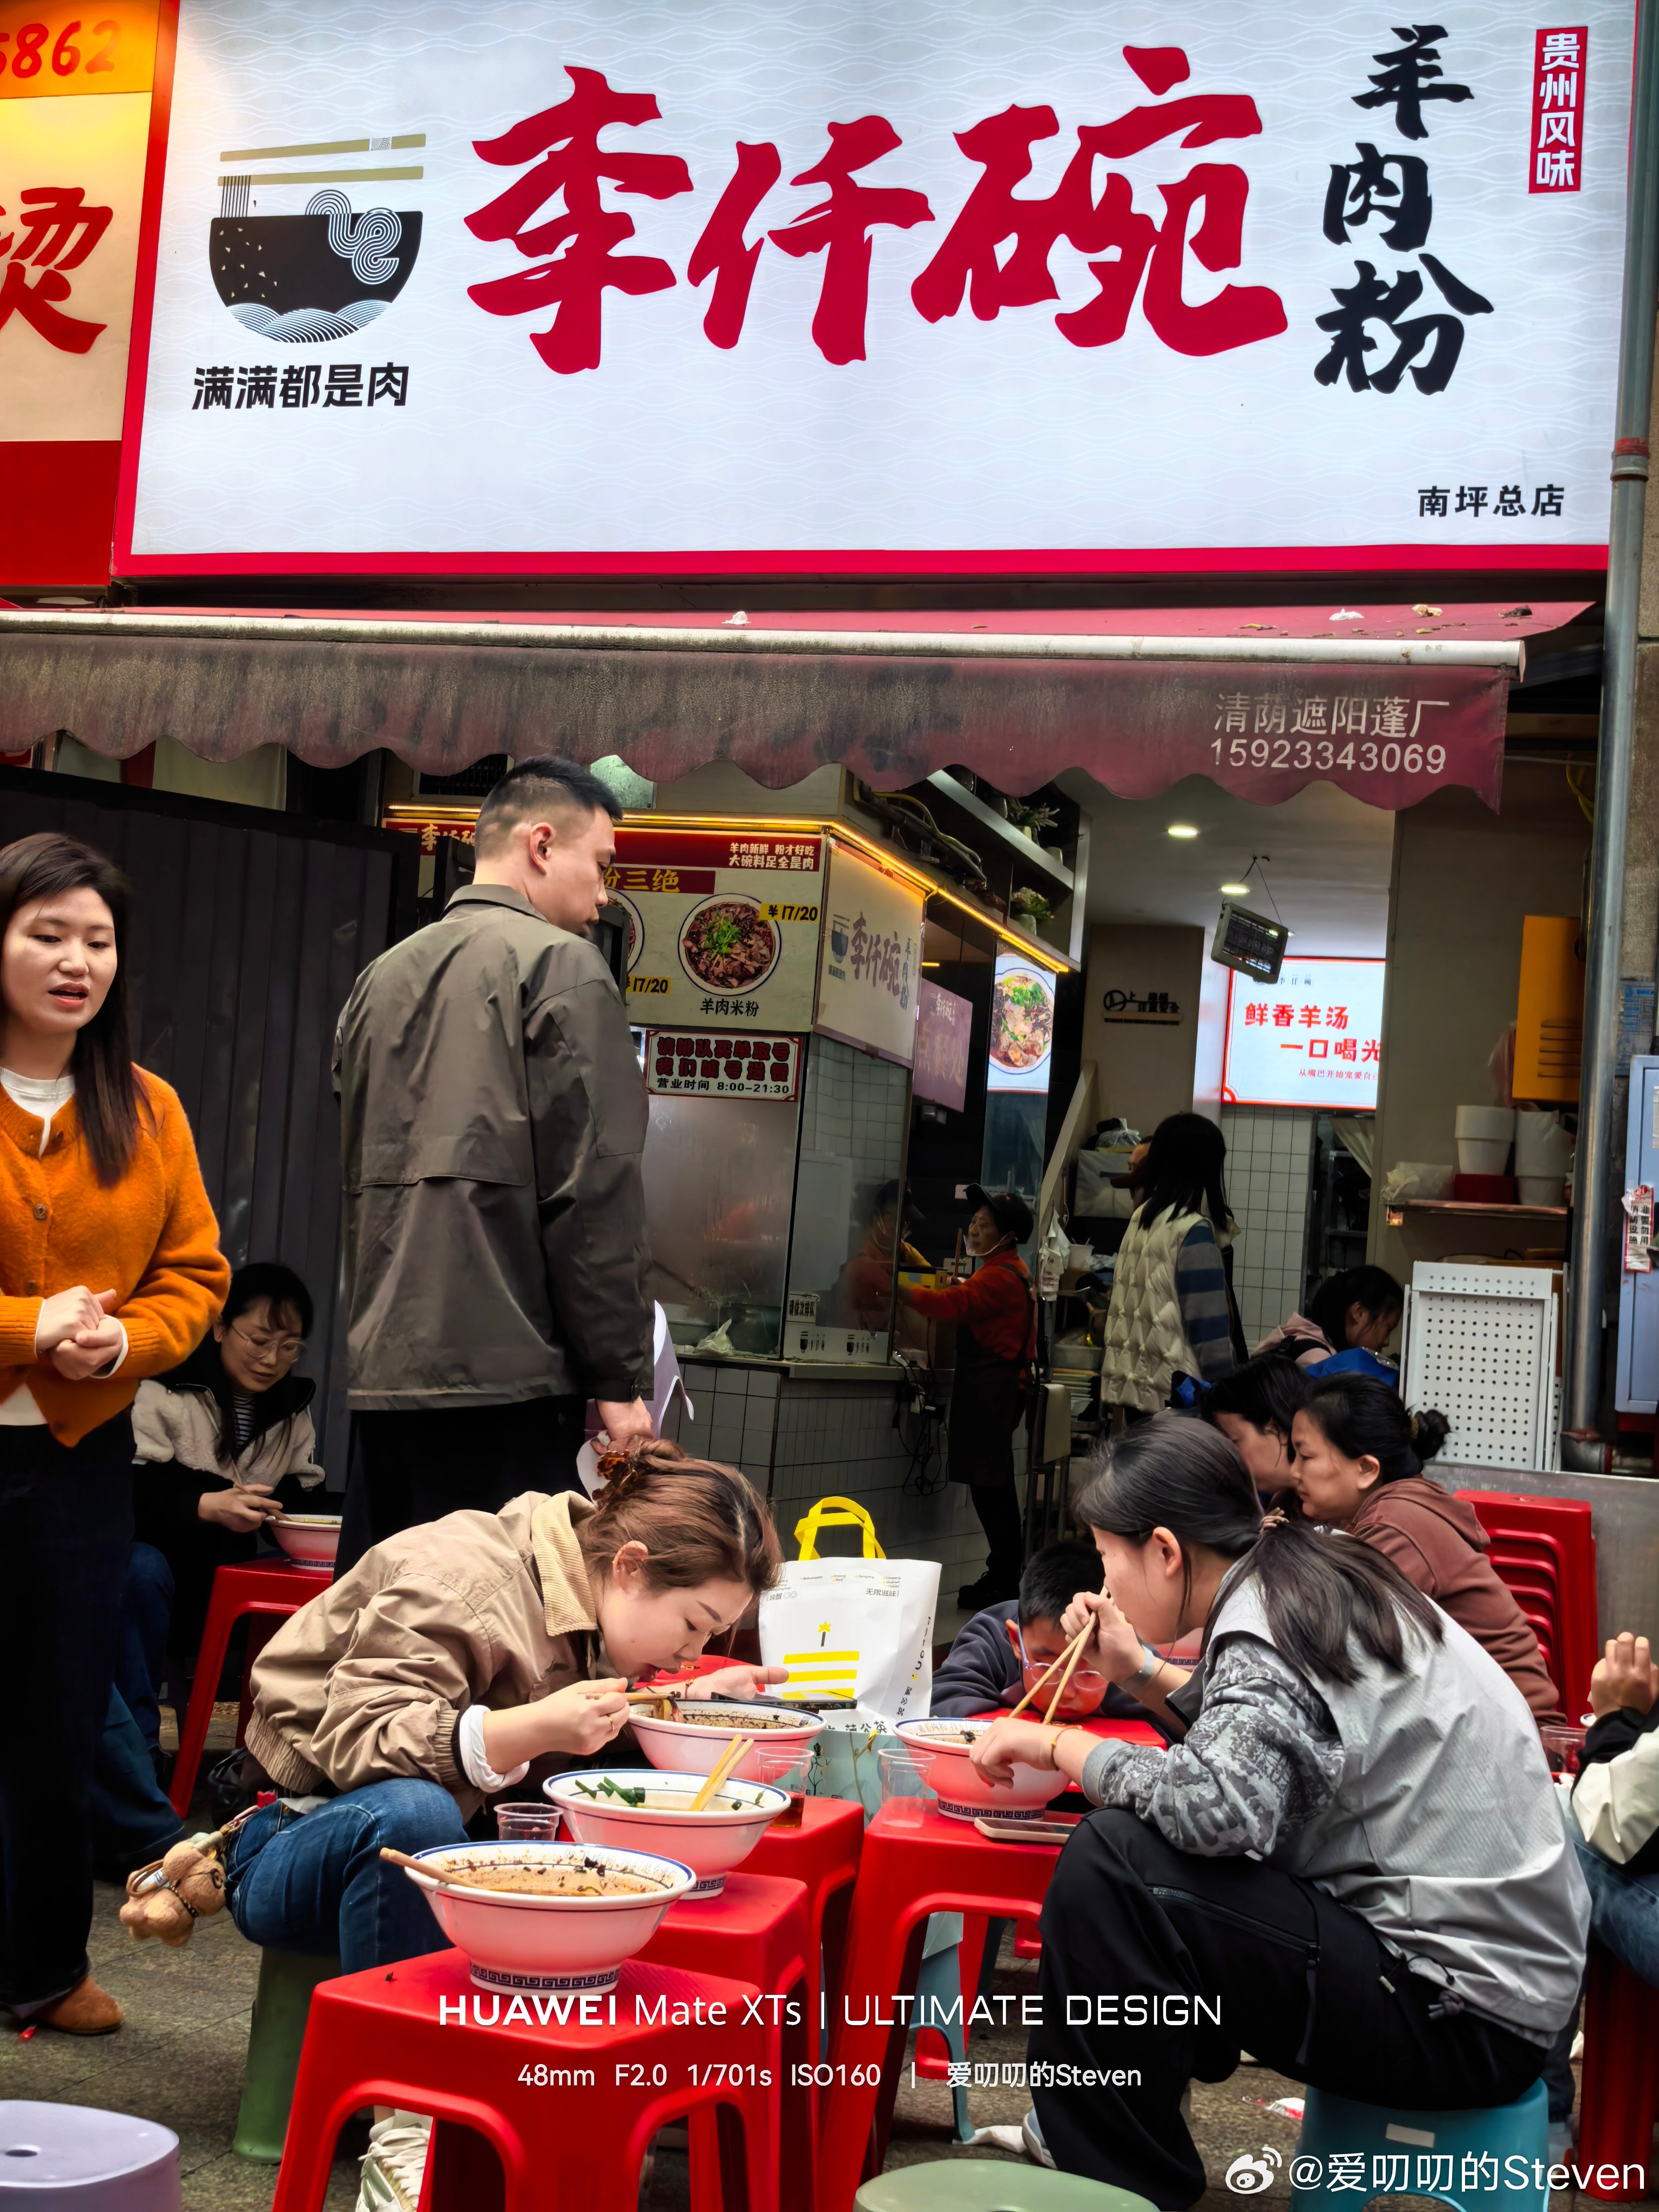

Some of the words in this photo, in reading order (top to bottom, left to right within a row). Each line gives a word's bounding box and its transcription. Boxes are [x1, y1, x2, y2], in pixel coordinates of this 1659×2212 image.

[1536, 33, 1580, 187] 贵州风味
[464, 46, 1287, 374] 李仟碗
[1314, 24, 1494, 395] 羊肉粉
[192, 362, 409, 410] 满满都是肉
[1418, 484, 1564, 517] 南坪总店
[1211, 738, 1446, 773] 15923343069
[729, 854, 814, 870] 大碗料足全是肉
[730, 842, 768, 855] 羊肉新鲜
[775, 844, 814, 856] 粉才好吃
[700, 998, 759, 1017] 羊肉米粉
[1244, 1002, 1349, 1030] 鲜香羊汤
[1280, 1038, 1380, 1063] 一口喝光
[657, 1078, 710, 1090] 营业时间
[717, 1082, 790, 1094] 8:00-21:30
